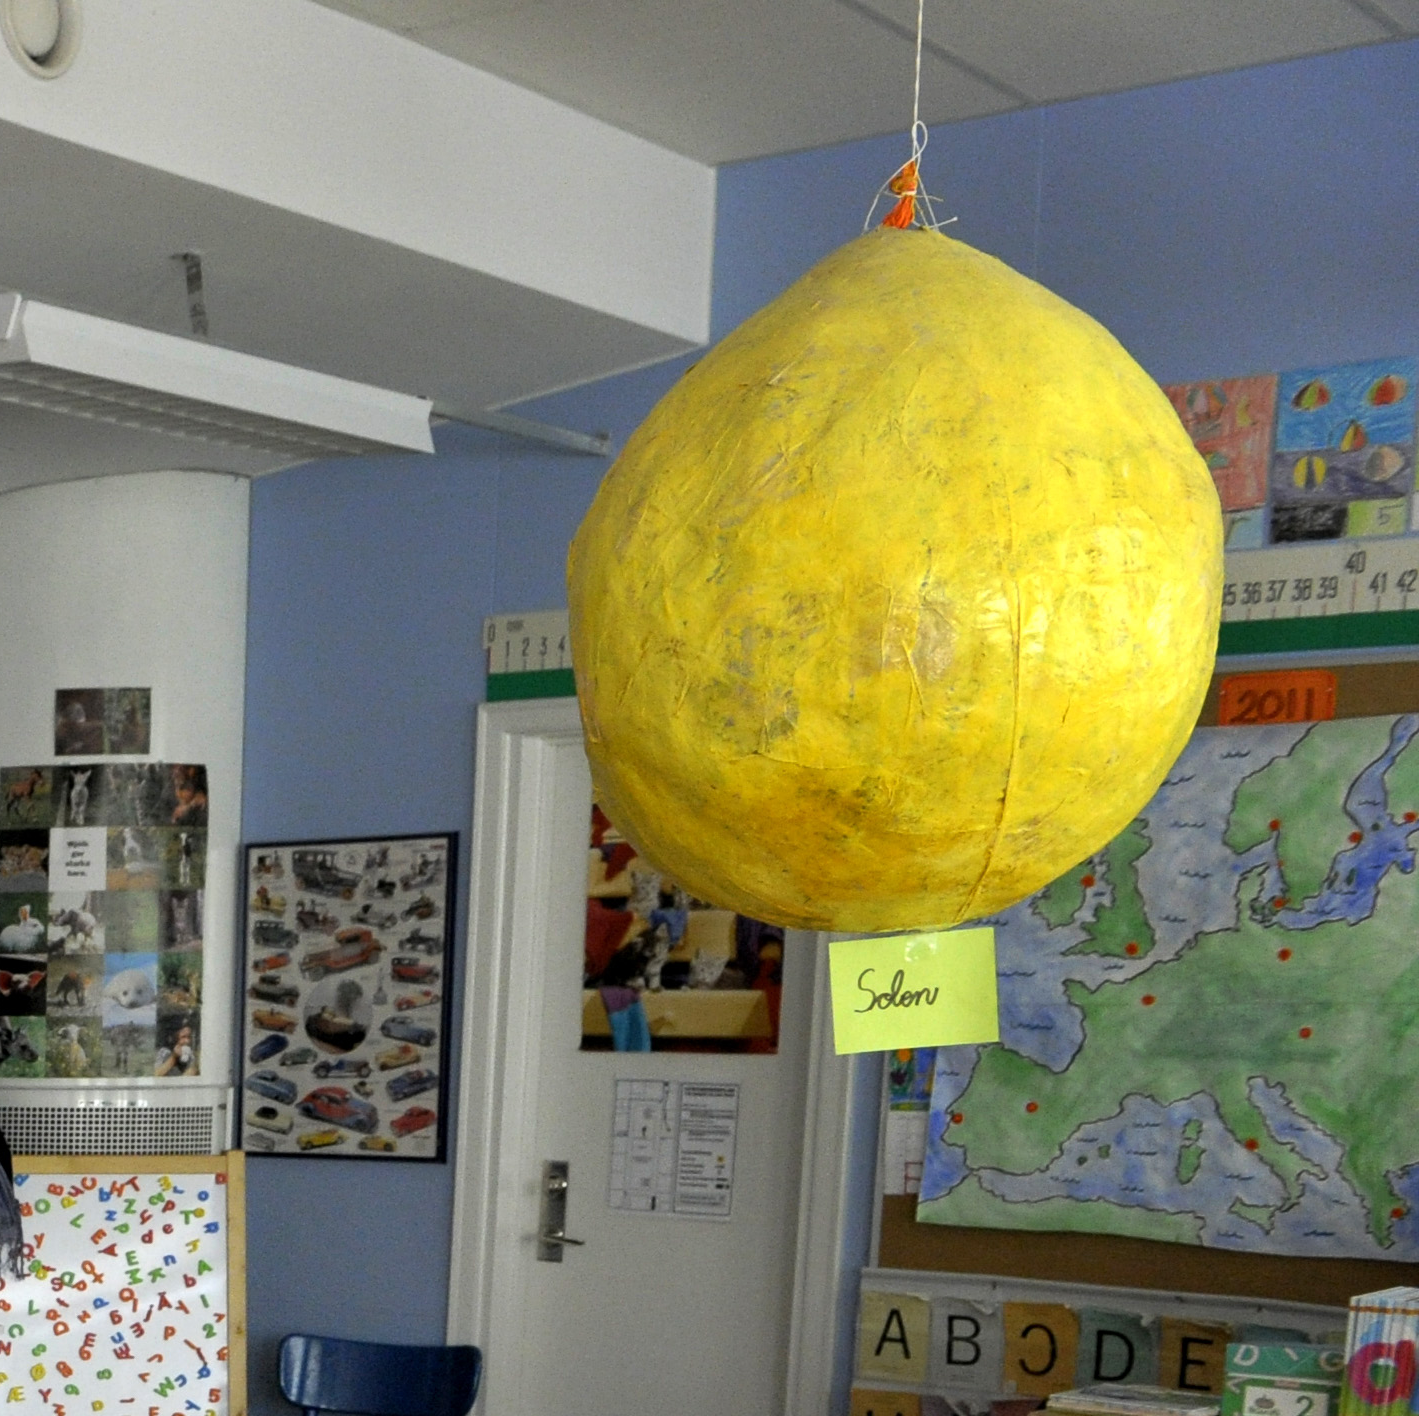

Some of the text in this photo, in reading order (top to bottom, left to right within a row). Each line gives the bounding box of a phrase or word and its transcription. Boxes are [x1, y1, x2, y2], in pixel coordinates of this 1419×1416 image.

[1242, 581, 1262, 606] 36
[1265, 579, 1287, 603] 37
[1291, 577, 1313, 601] 38
[1317, 576, 1338, 600] 39
[1344, 550, 1366, 574] 40
[1369, 572, 1388, 594] 41
[1395, 569, 1418, 593] 42
[522, 636, 530, 657] 2
[1229, 687, 1315, 724] 2011
[125, 1250, 139, 1266] E
[198, 1259, 212, 1276] A
[202, 1323, 217, 1339] 2
[874, 1307, 982, 1367] A B
[1092, 1330, 1215, 1391] D E
